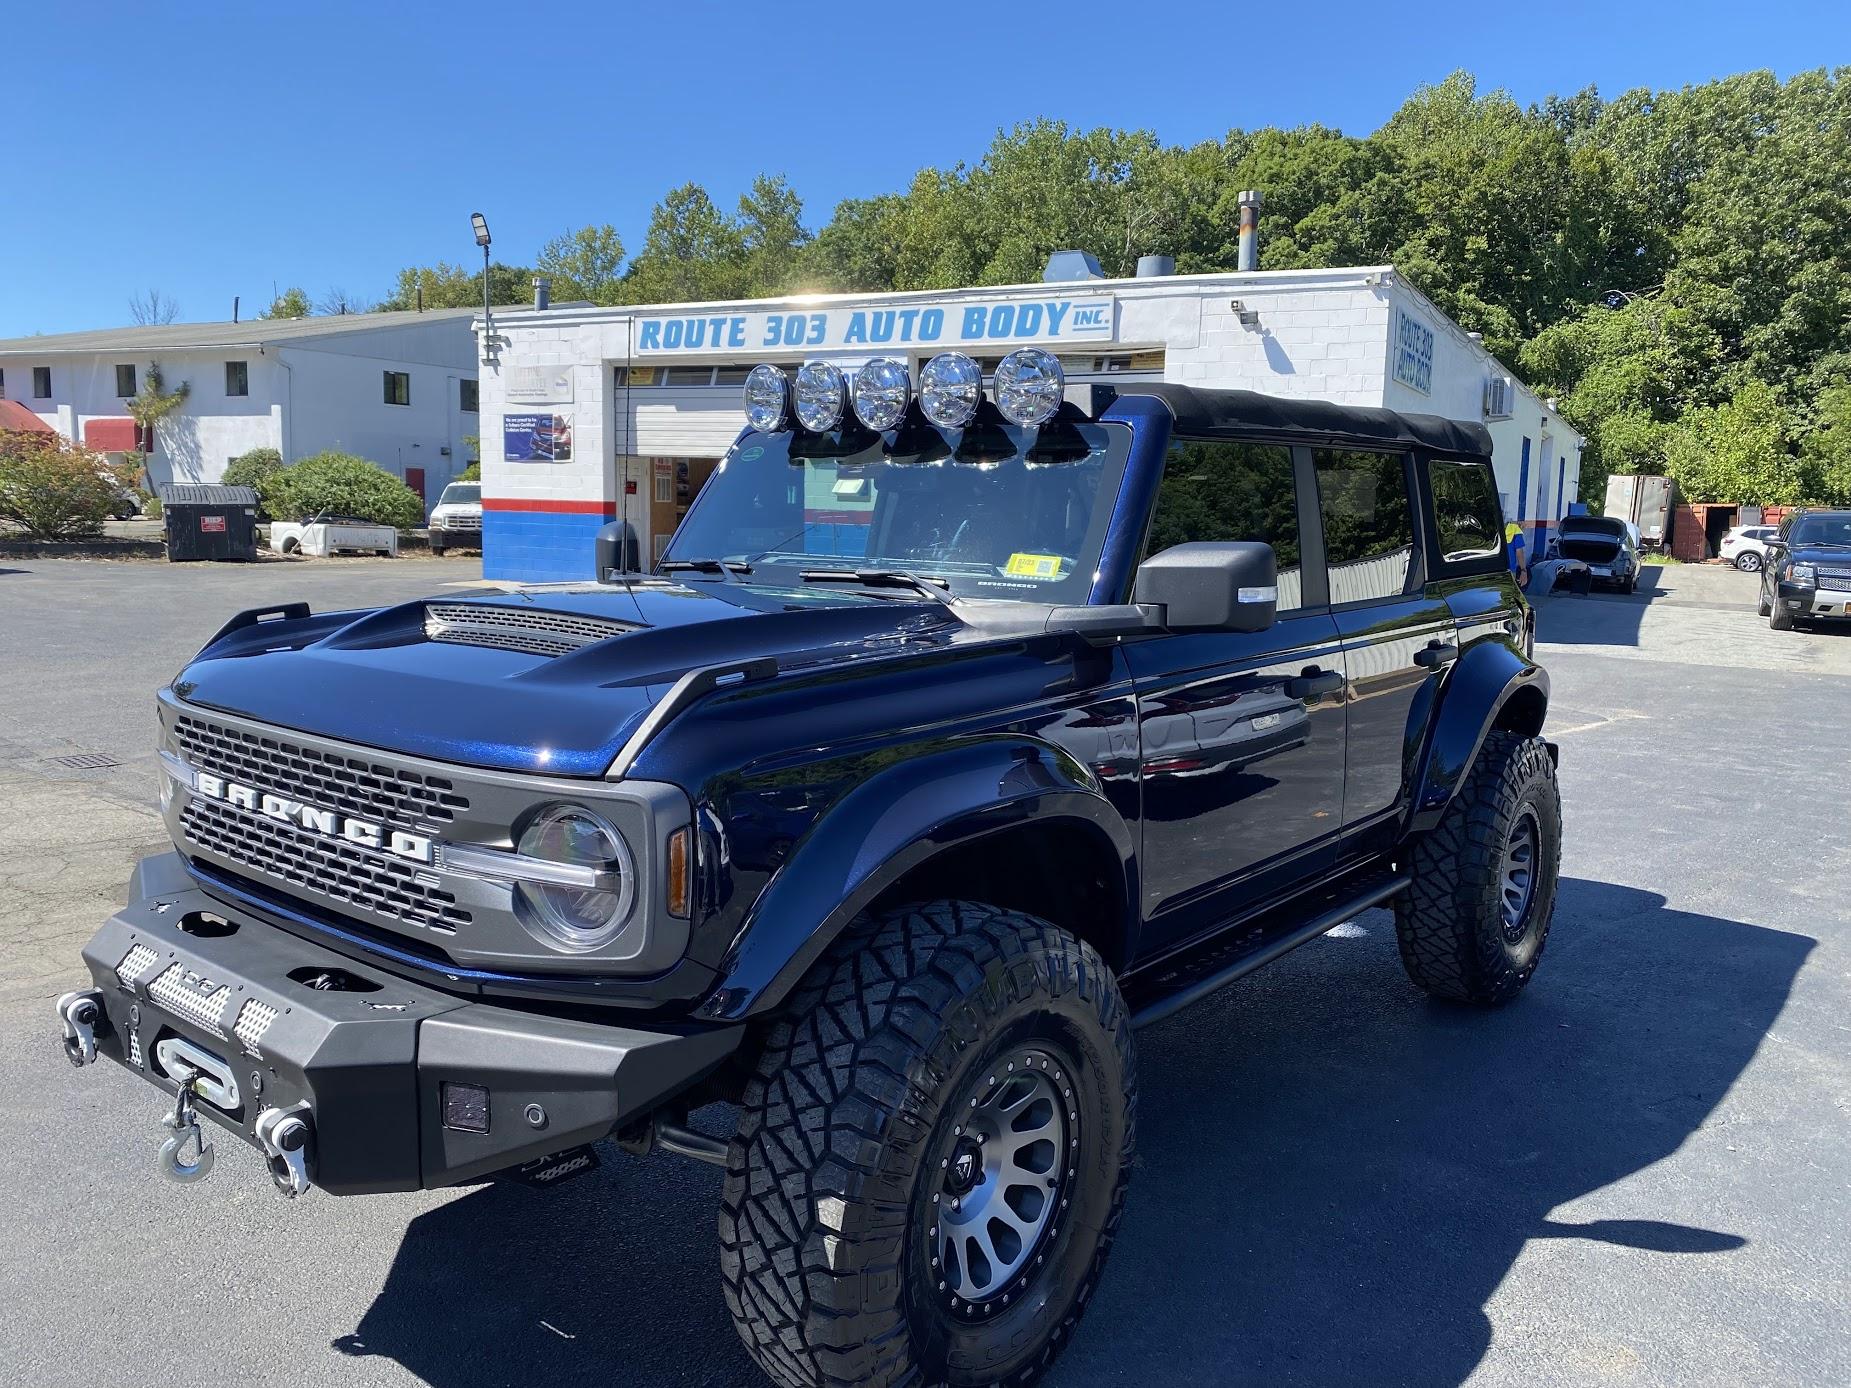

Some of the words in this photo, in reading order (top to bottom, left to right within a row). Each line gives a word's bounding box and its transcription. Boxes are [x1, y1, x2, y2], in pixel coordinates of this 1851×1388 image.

[640, 317, 746, 349] ROUTE
[763, 314, 827, 346] 303
[844, 308, 944, 343] AUTO
[961, 302, 1071, 339] BODY
[1073, 310, 1109, 325] INC.
[1400, 313, 1421, 353] ROUTE
[1421, 330, 1433, 361] 303
[1397, 348, 1416, 384] AUTO
[978, 581, 1037, 589] BRONCO
[198, 771, 433, 863] BRONCO
